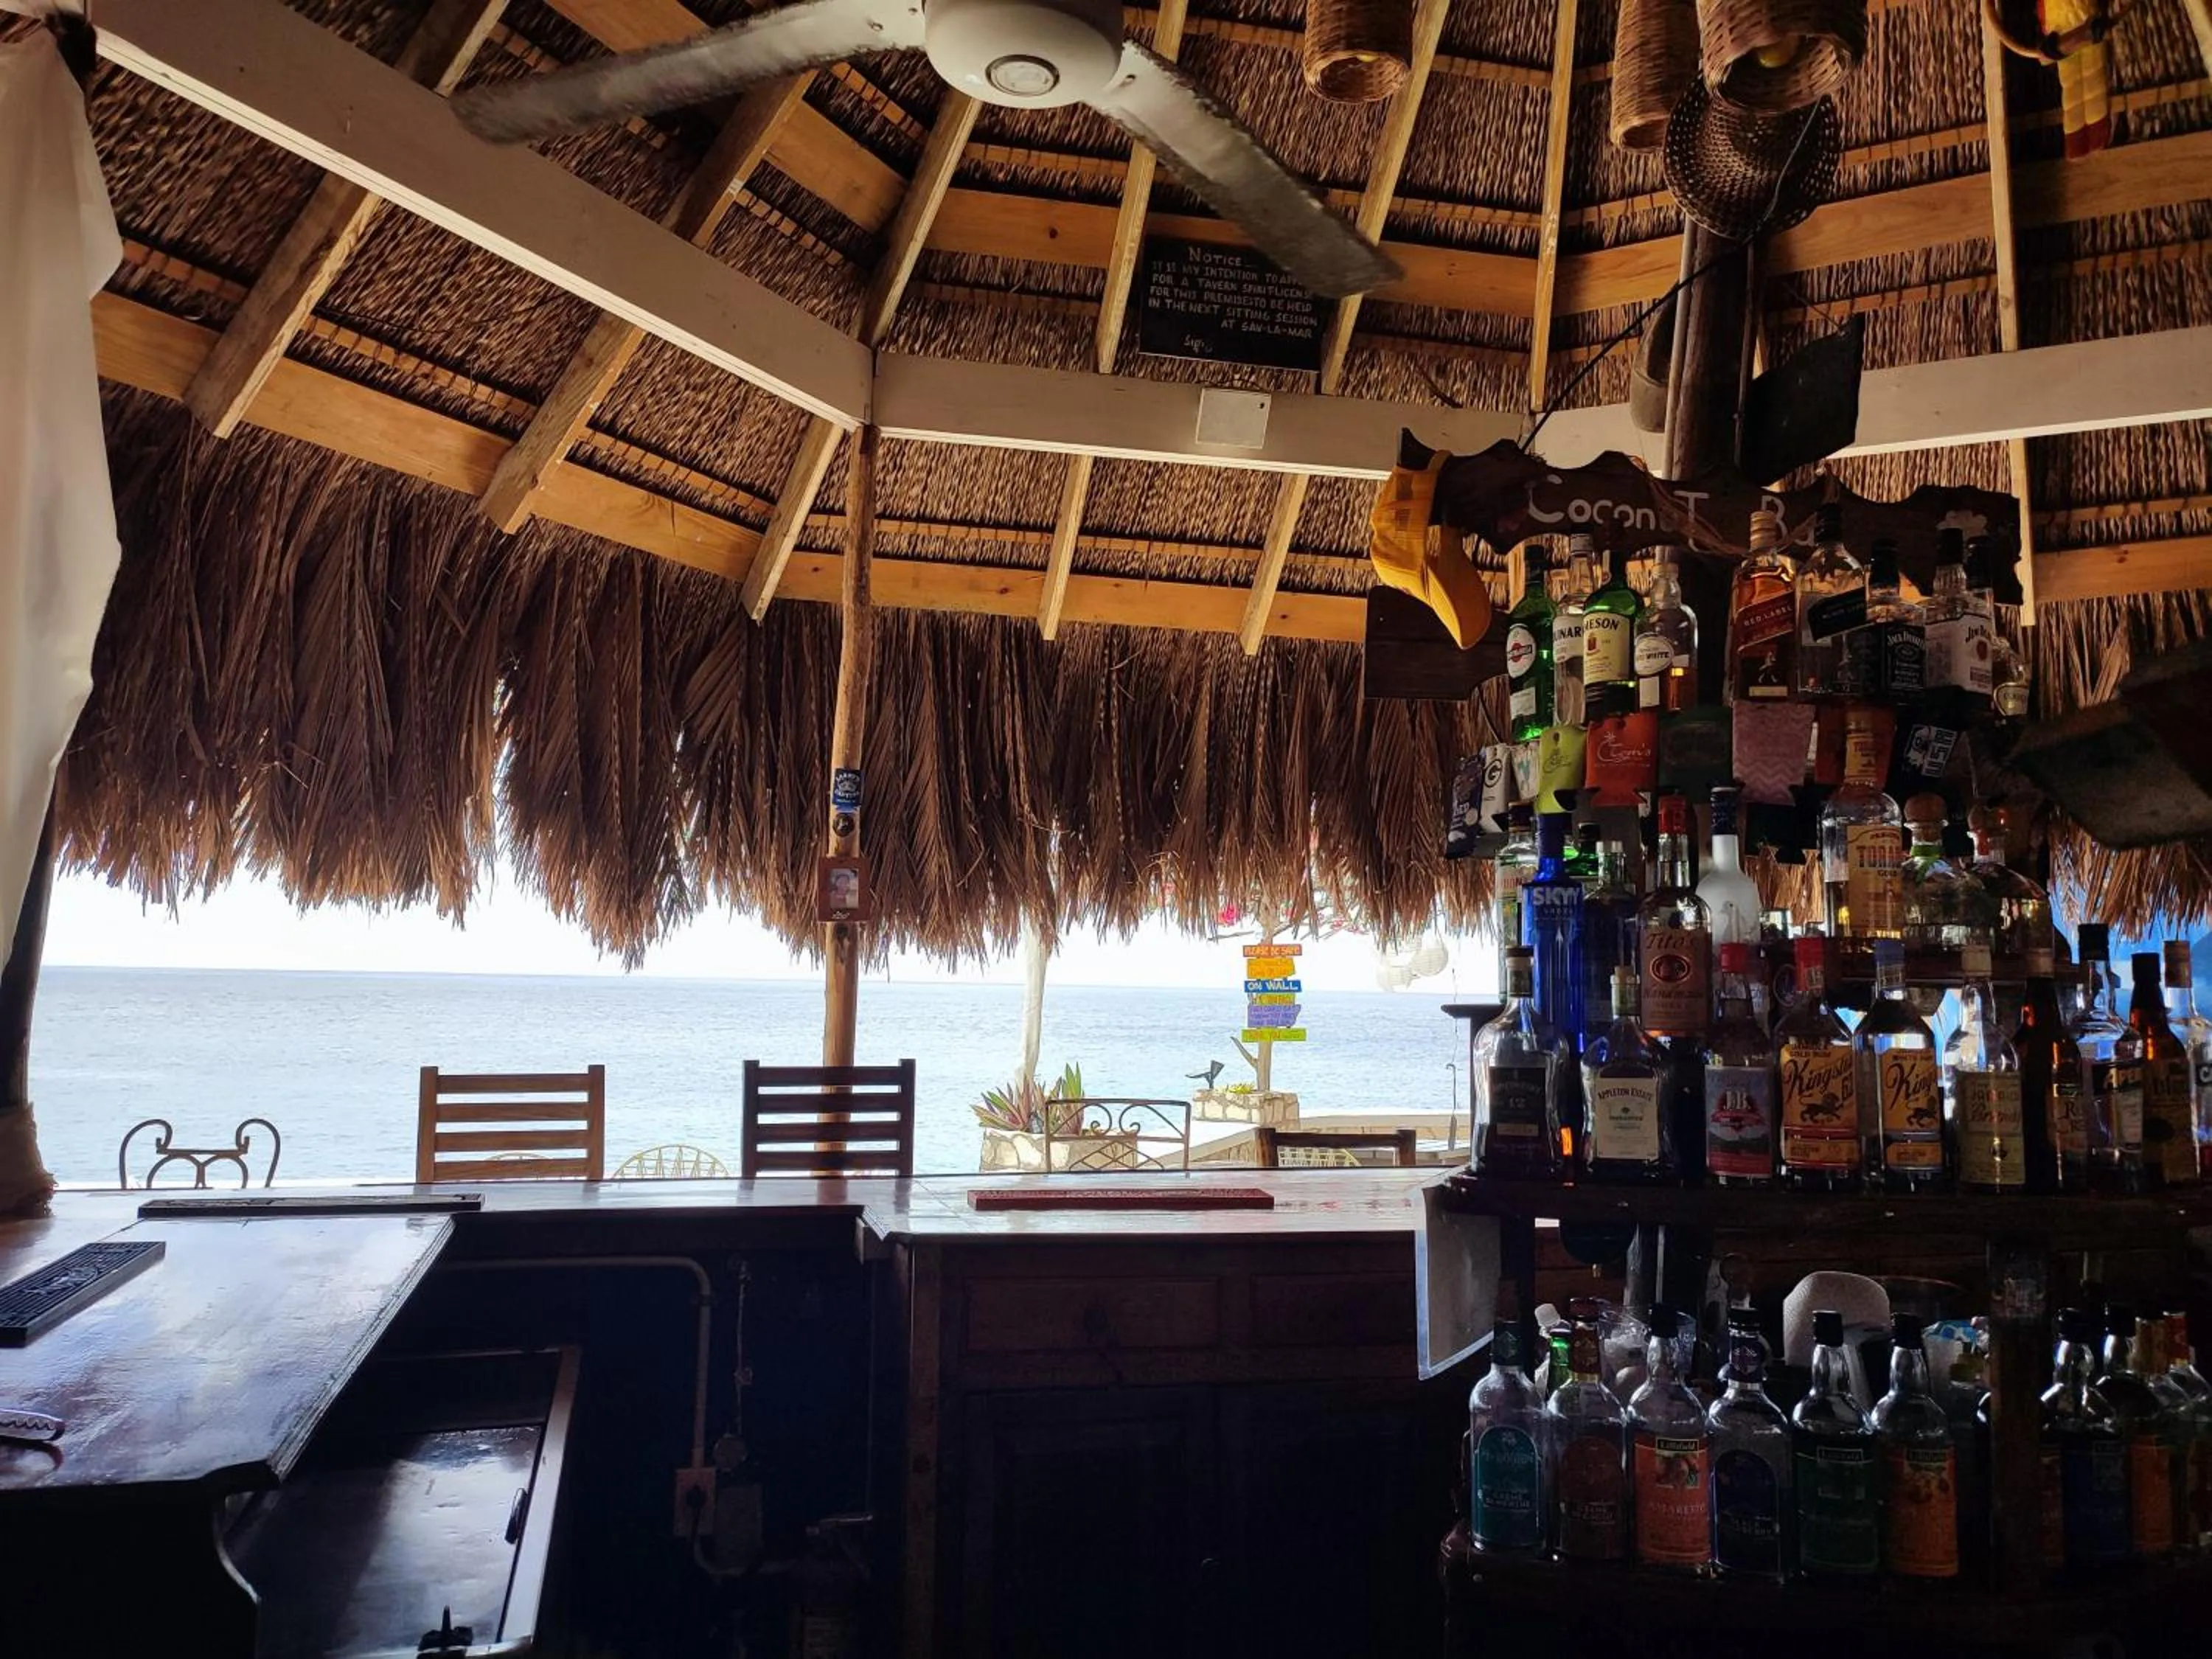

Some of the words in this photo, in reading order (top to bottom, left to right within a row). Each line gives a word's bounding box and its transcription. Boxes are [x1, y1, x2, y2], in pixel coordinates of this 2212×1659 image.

[1182, 265, 1200, 276] MY
[1152, 273, 1174, 285] FOR
[1198, 277, 1239, 292] TAVERN
[1275, 285, 1315, 300] LICENS
[1150, 285, 1170, 297] FOR
[1173, 288, 1197, 301] THIS
[1286, 299, 1312, 313] HELD
[1148, 297, 1161, 309] IN
[1165, 299, 1188, 312] THE
[1188, 302, 1221, 316] NEXT
[1274, 312, 1318, 327] SESSION
[1220, 319, 1237, 330] AT
[1534, 886, 1581, 906] SKYY
[1265, 981, 1298, 990] WALL
